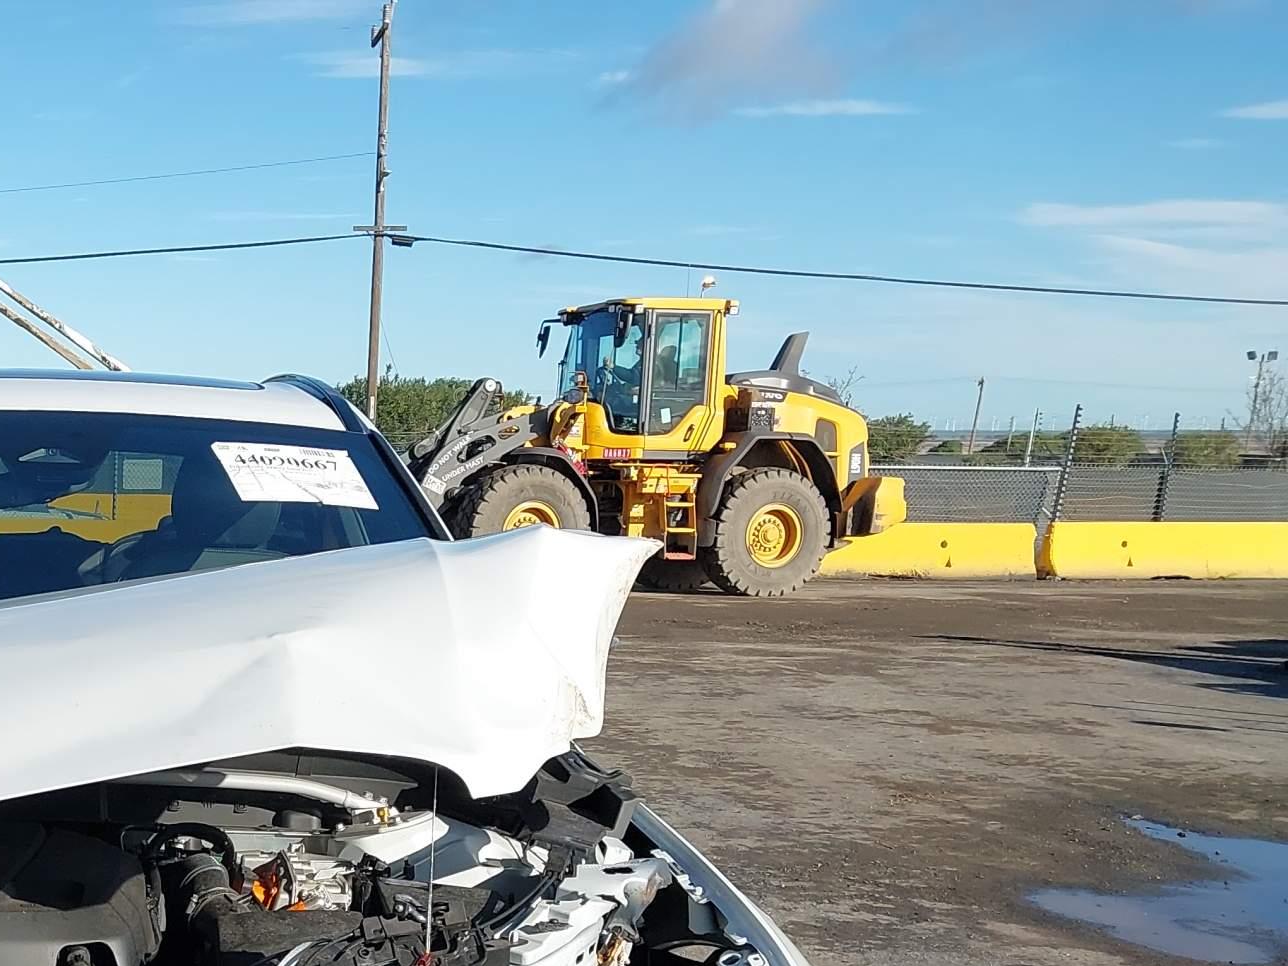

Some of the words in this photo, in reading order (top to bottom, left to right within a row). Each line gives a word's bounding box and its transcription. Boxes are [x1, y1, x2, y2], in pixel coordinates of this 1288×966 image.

[428, 463, 440, 474] DO
[439, 448, 454, 465] NOT
[453, 431, 473, 452] WALK
[441, 466, 466, 481] UNDER
[466, 456, 484, 470] MAST
